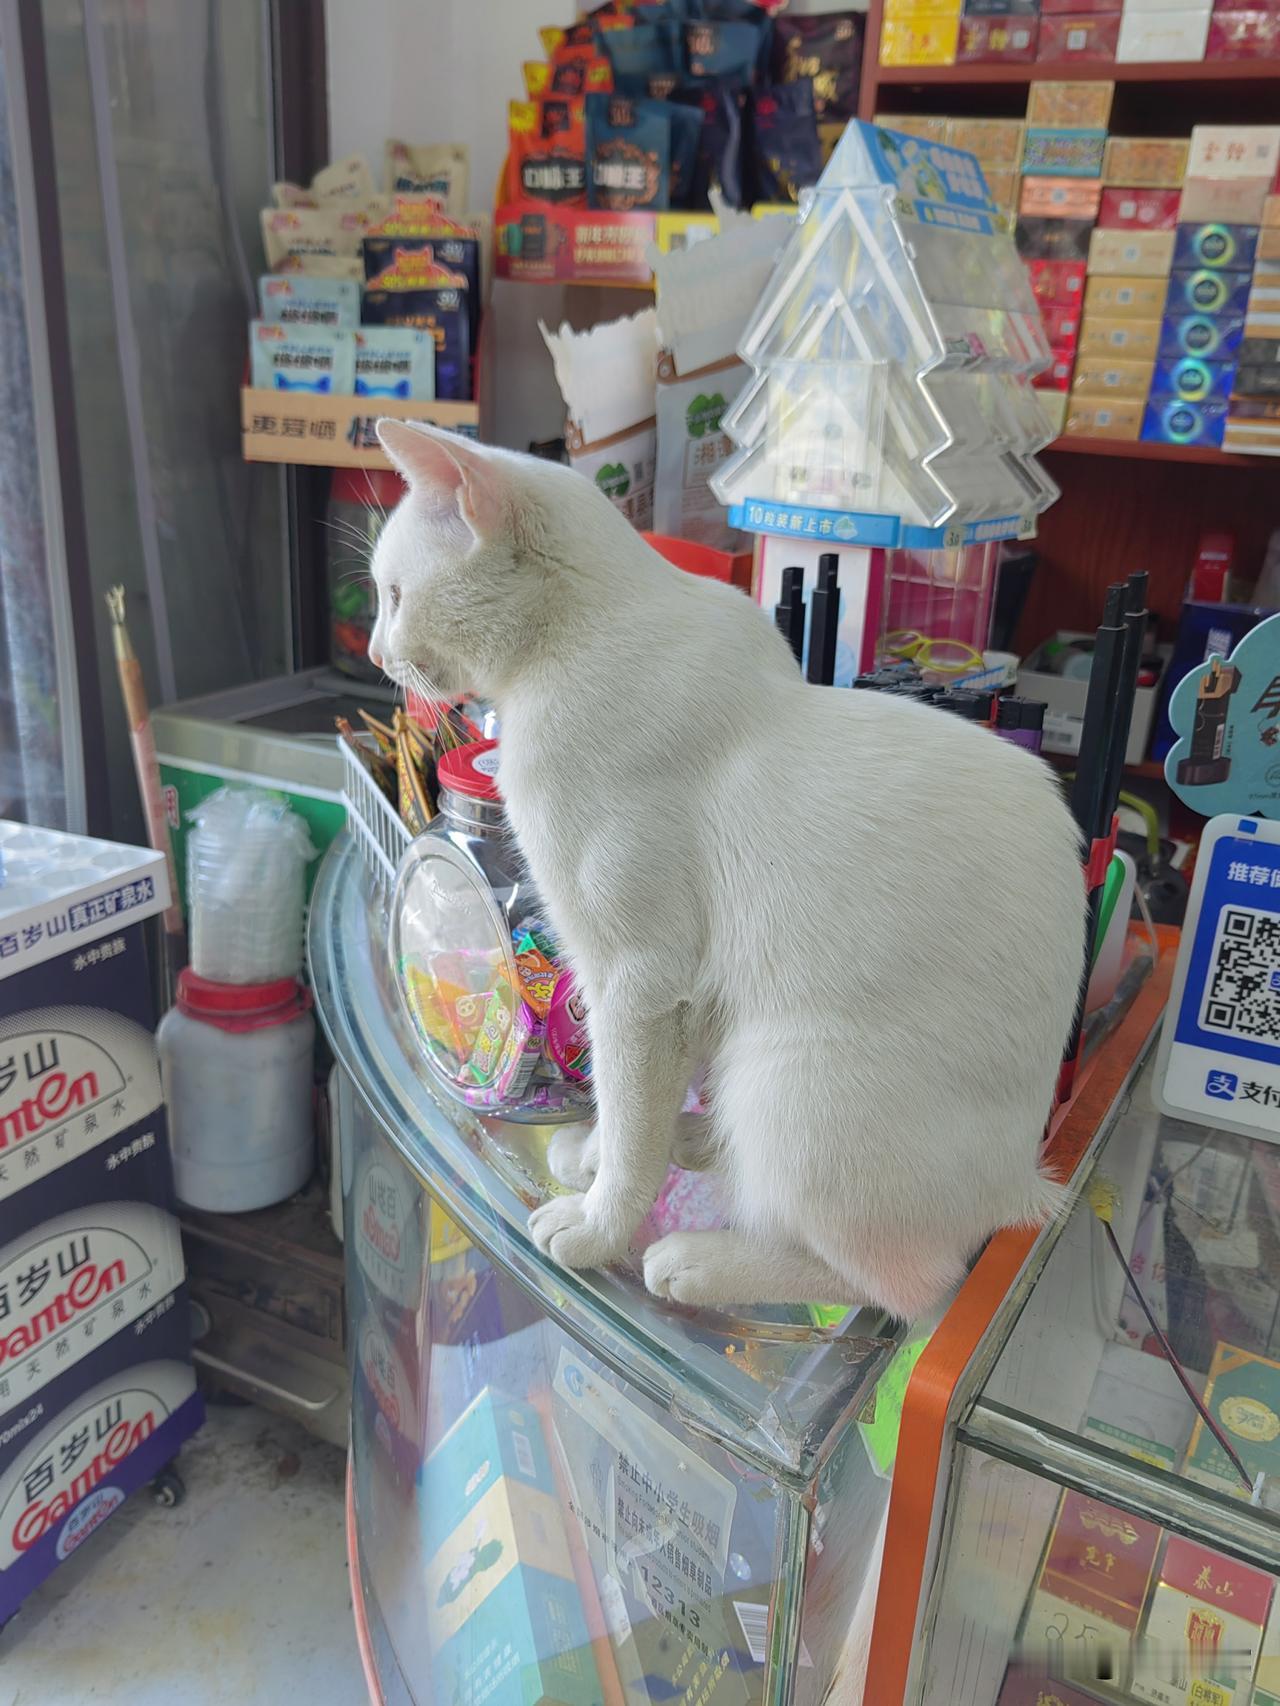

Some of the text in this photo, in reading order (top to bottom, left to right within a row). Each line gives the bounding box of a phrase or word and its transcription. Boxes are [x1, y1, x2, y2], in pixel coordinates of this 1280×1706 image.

[749, 503, 833, 535] 10粒装新上市
[0, 877, 154, 958] 百岁山 真正矿泉水
[72, 937, 127, 972] 水中贵族
[12, 1410, 156, 1552] Ganten
[24, 1399, 123, 1503] 百岁山
[618, 1448, 721, 1550] 禁止中小学生吸烟
[641, 1566, 701, 1629] 12313
[1192, 1565, 1234, 1597] 泰山
